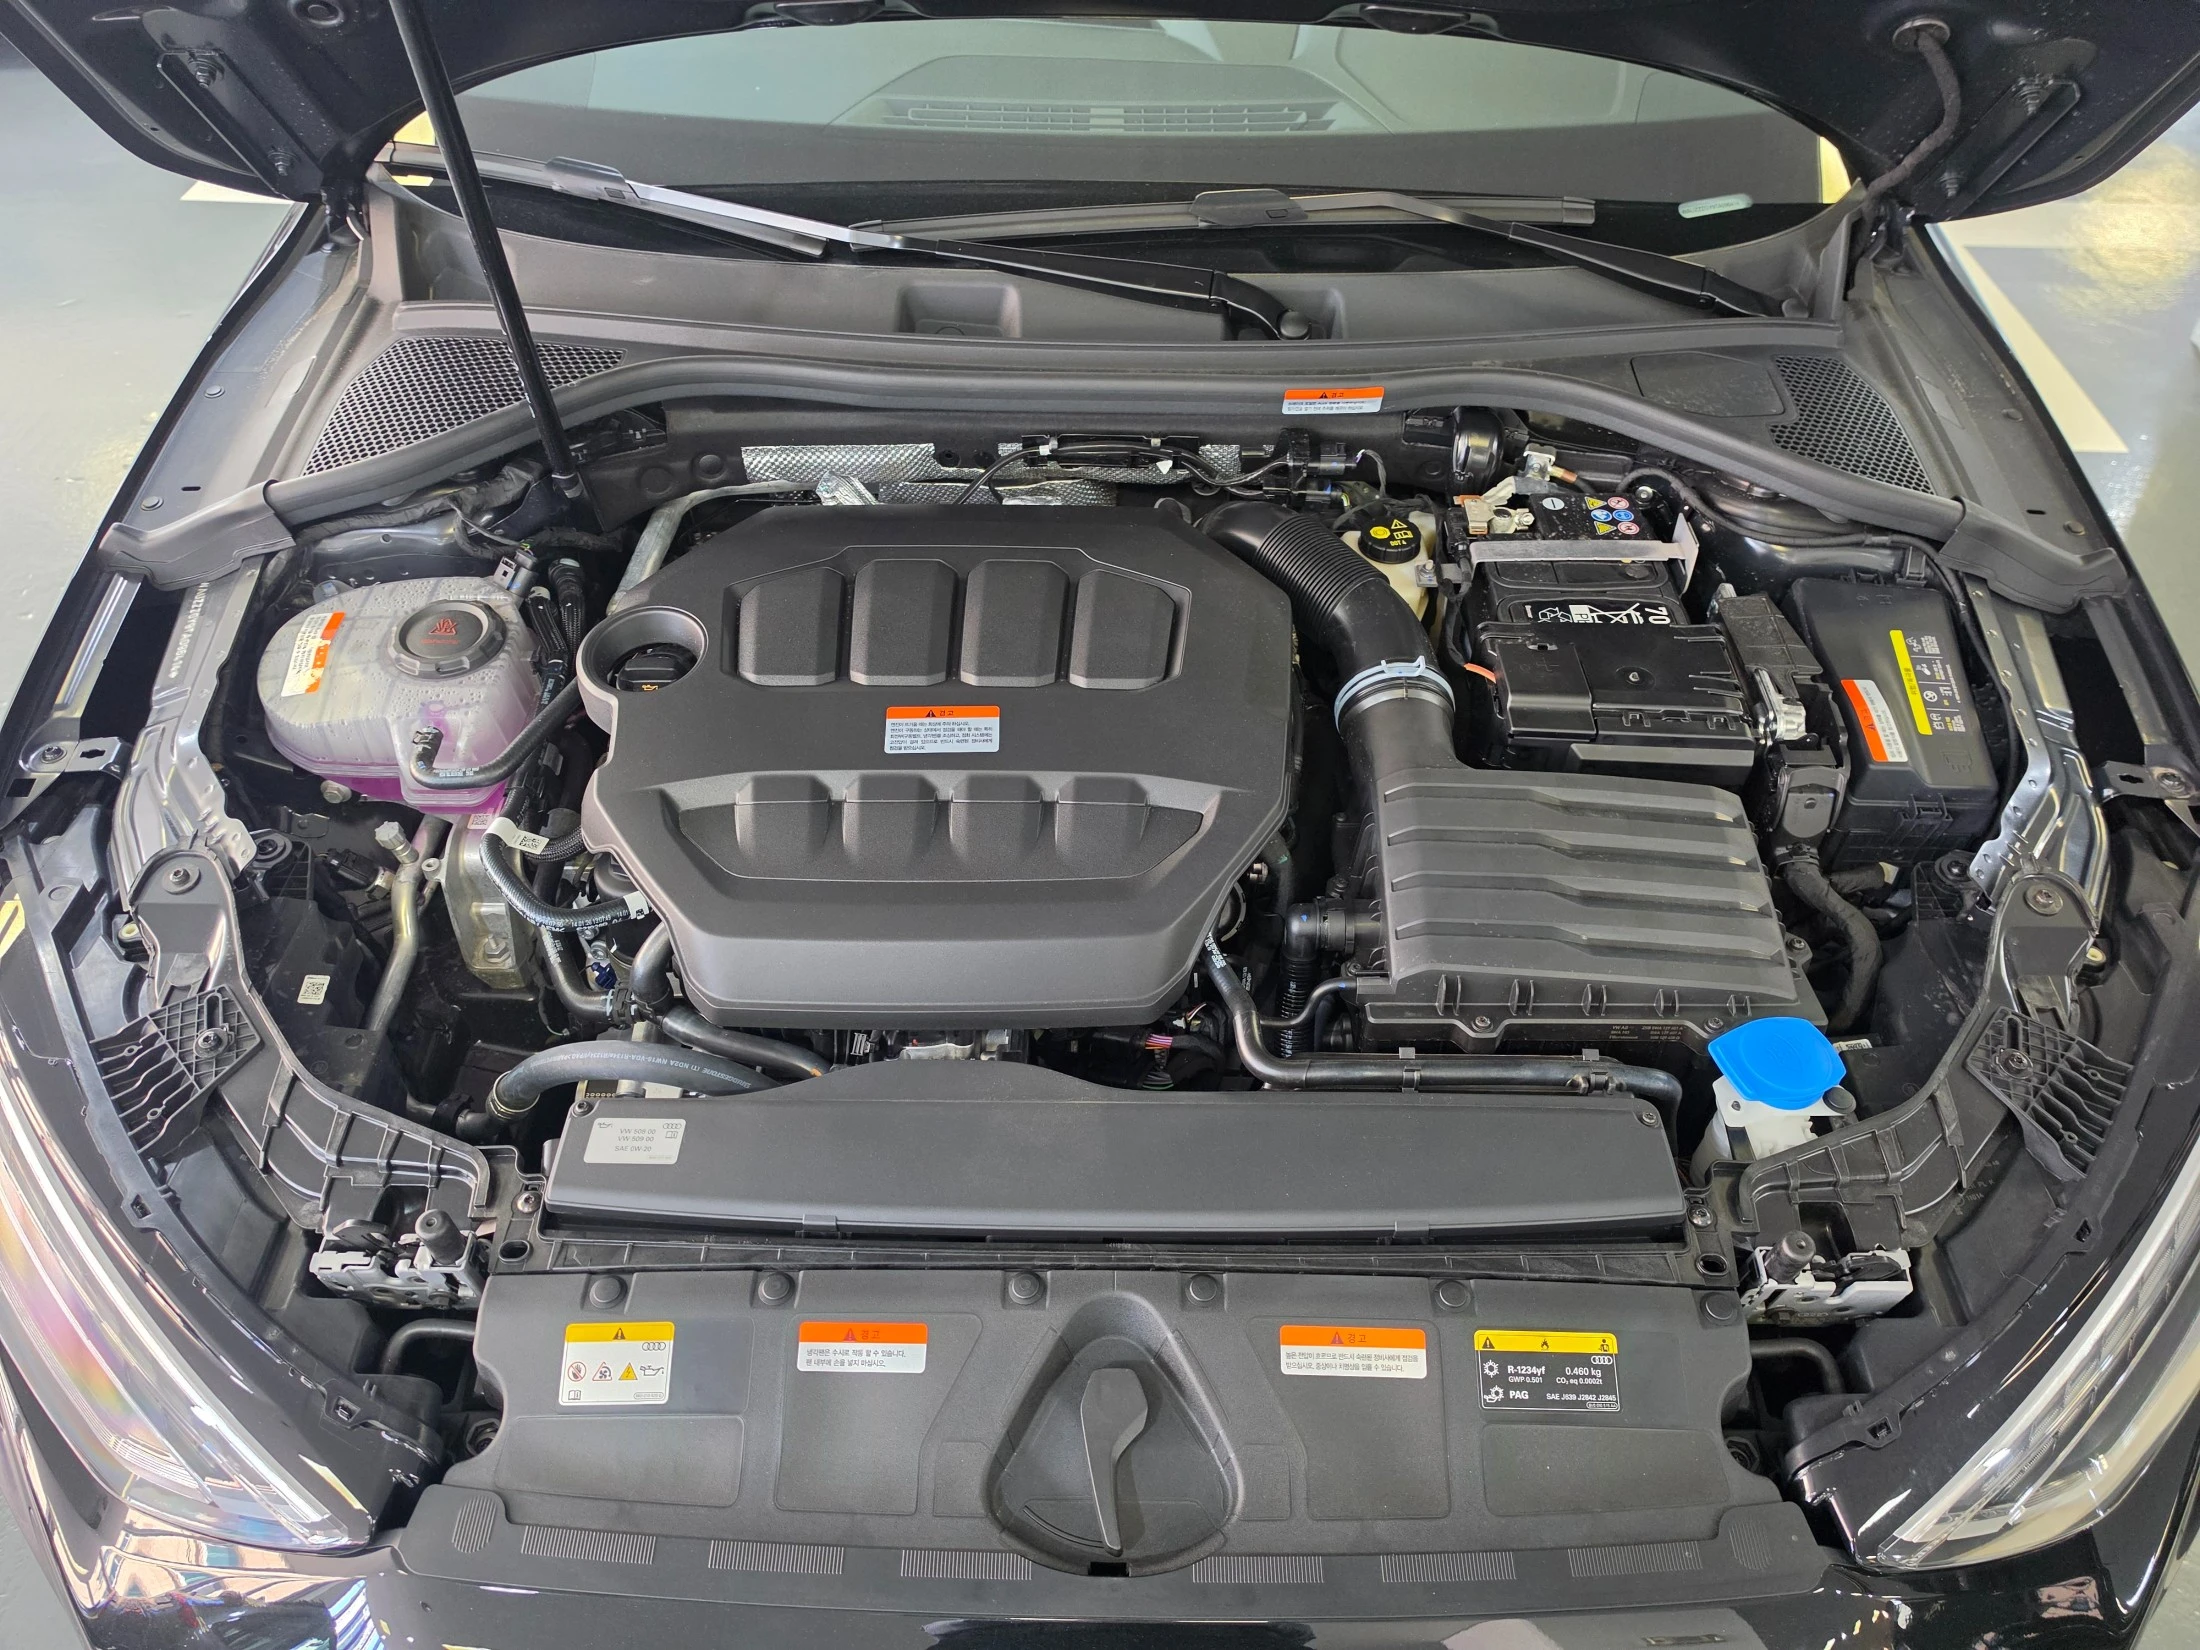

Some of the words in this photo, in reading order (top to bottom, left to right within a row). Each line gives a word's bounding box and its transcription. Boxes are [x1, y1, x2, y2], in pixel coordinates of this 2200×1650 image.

[1645, 607, 1671, 624] 70
[702, 1067, 751, 1089] BRIDGESTONE
[806, 1349, 831, 1357] 냉각팬은
[832, 1349, 850, 1357] 수시로
[851, 1349, 863, 1357] 작동
[865, 1349, 872, 1357] 할
[873, 1349, 880, 1357] 수
[881, 1349, 906, 1357] 있습니다.
[1338, 1353, 1355, 1361] 반드시
[813, 1359, 831, 1367] 내부에
[833, 1359, 846, 1367] 손을
[847, 1359, 860, 1367] 넣지
[1373, 1363, 1380, 1371] 수
[1507, 1365, 1546, 1376] R-1234yf
[1565, 1366, 1589, 1376] 0.460
[1591, 1367, 1602, 1377] kg
[1510, 1390, 1529, 1399] PAG
